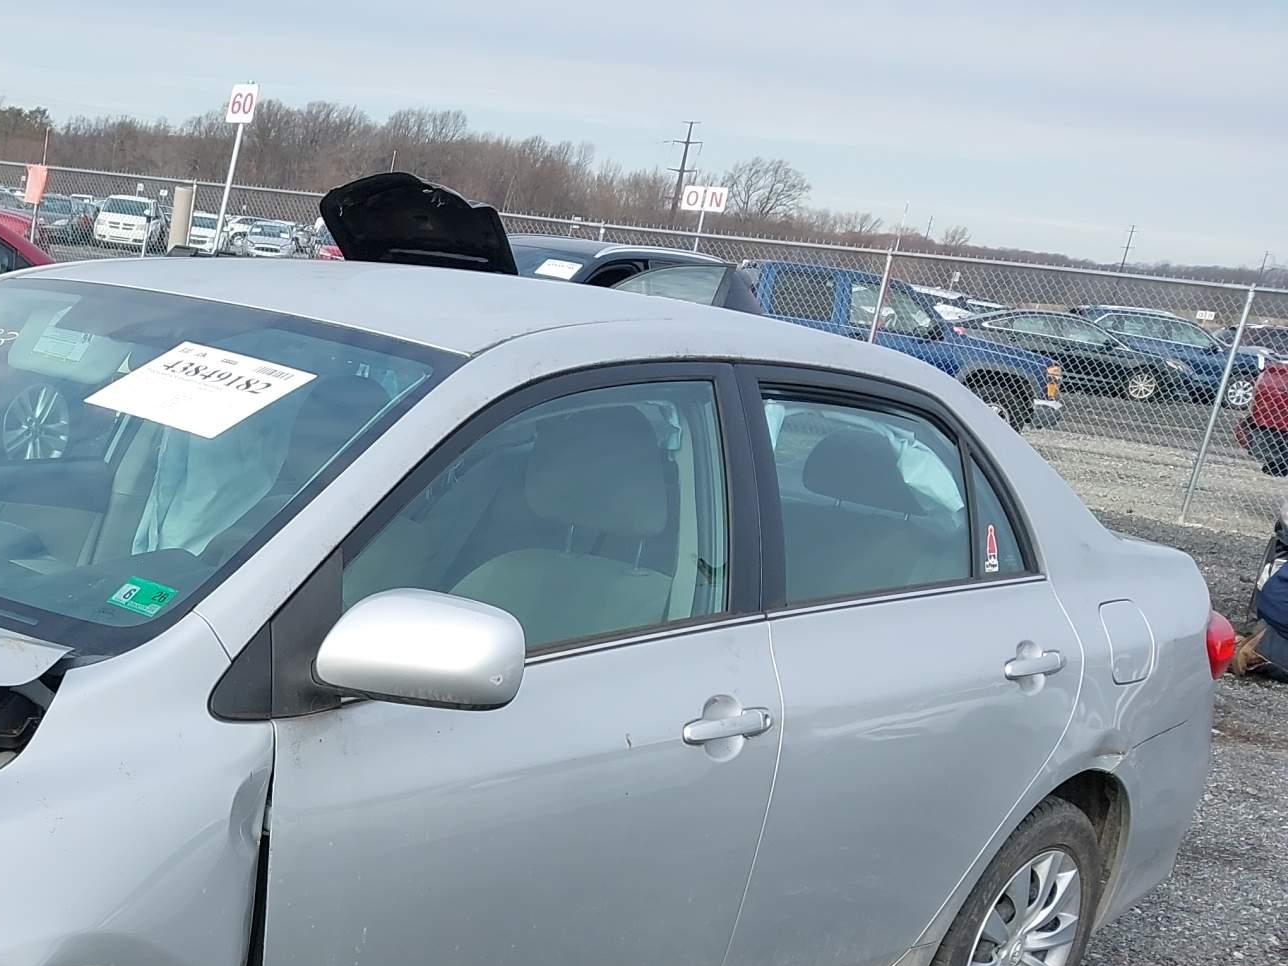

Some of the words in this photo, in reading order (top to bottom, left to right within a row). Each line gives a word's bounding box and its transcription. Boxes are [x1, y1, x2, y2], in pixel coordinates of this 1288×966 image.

[231, 92, 254, 114] 60
[686, 190, 699, 206] O
[709, 191, 723, 208] N
[162, 359, 273, 395] 43849182
[122, 588, 137, 600] 6
